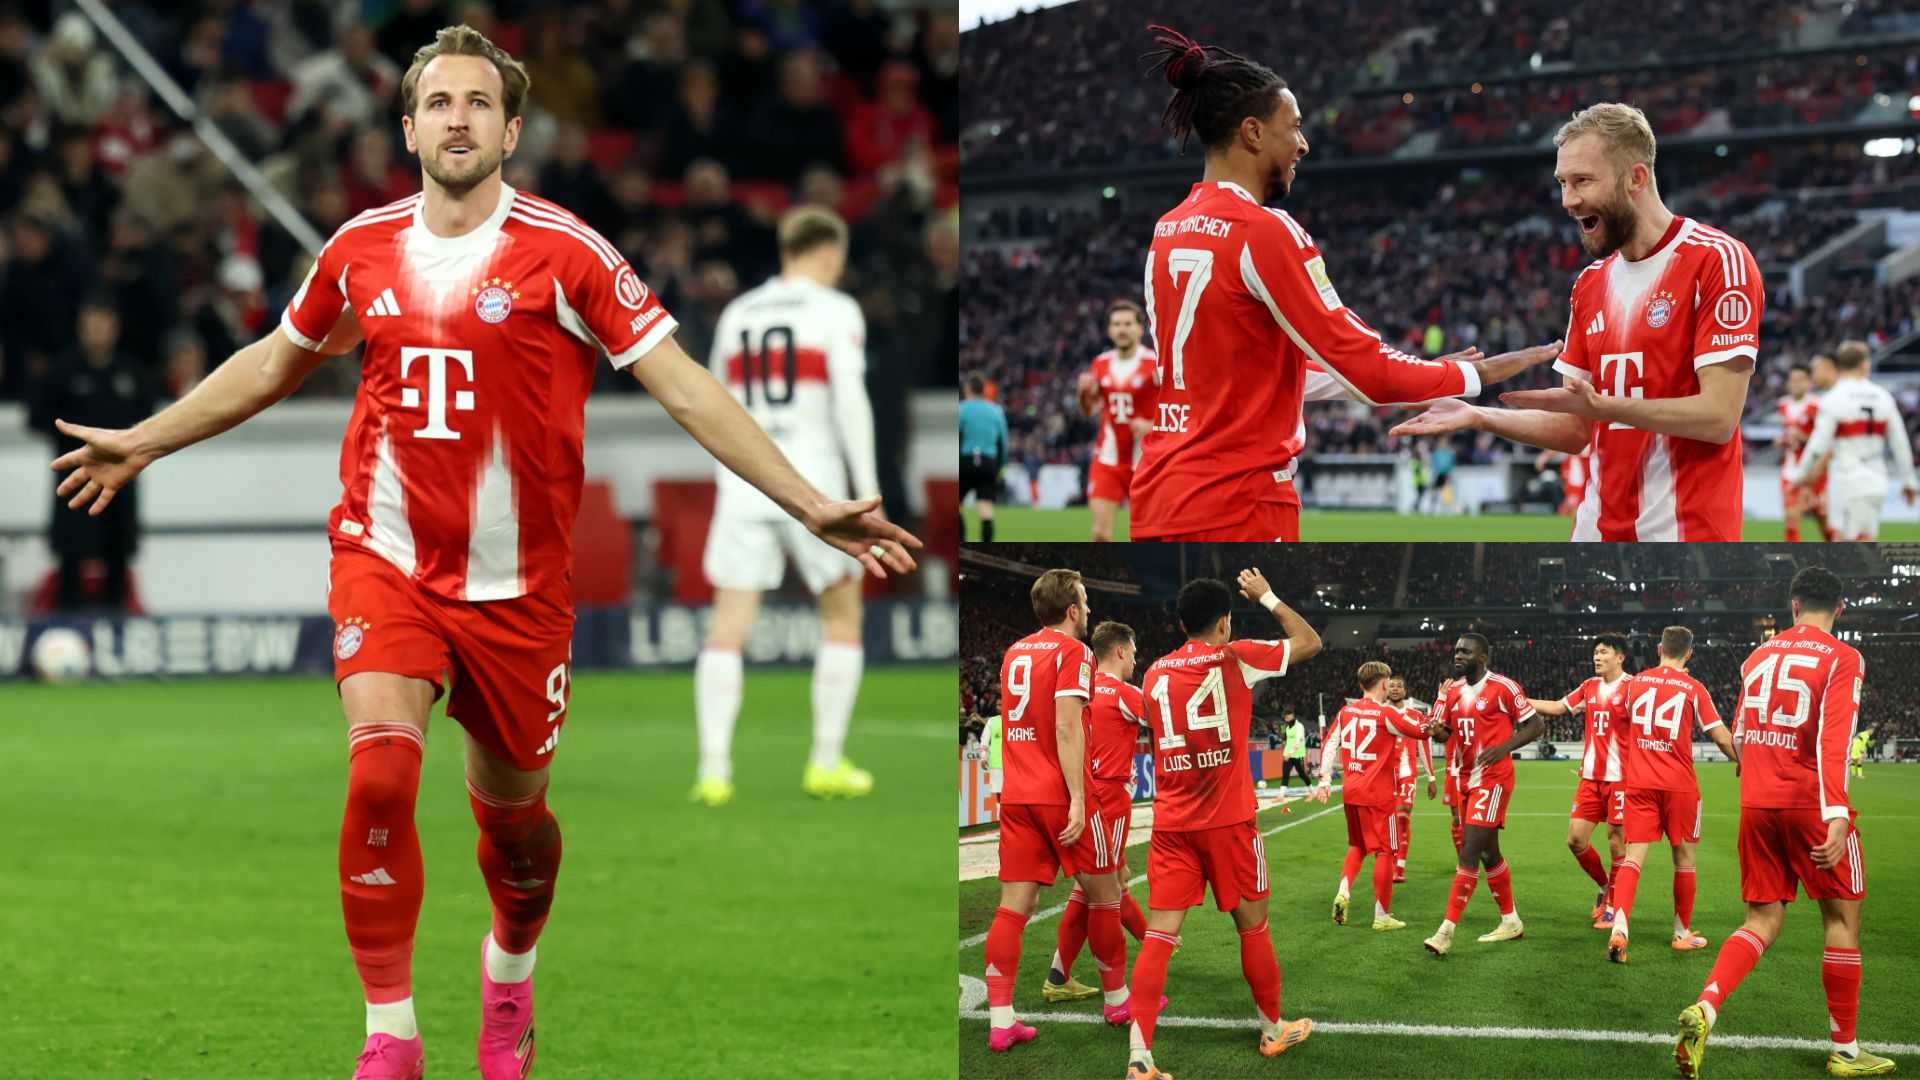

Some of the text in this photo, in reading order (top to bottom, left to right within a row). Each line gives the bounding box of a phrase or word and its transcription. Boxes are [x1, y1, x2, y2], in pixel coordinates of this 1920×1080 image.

[1178, 214, 1232, 238] MÜNCHEN
[1711, 333, 1755, 346] Allianz
[741, 326, 796, 408] 10
[400, 346, 475, 440] T
[1108, 392, 1134, 424] T
[1153, 402, 1191, 433] ISE
[1157, 656, 1186, 669] BAYERN
[1187, 649, 1225, 666] MÜNCHEN
[1793, 640, 1835, 654] MÜNCHEN
[545, 662, 567, 722] 9
[1007, 654, 1032, 722] 9
[1743, 653, 1820, 729] 45
[1149, 666, 1232, 751] 14
[1632, 687, 1687, 740] 44
[1007, 726, 1038, 742] KANE
[1457, 717, 1474, 746] T
[1593, 710, 1610, 736] T
[1340, 716, 1377, 761] 42
[1636, 738, 1673, 753] STANIŠIĆ
[1744, 729, 1798, 751] PAVLOVIĆ
[1163, 748, 1232, 773] LUIS DÍAZ
[1348, 761, 1364, 772] KARL
[1400, 783, 1415, 797] 17
[1474, 788, 1490, 810] 2
[1614, 790, 1625, 810] 3
